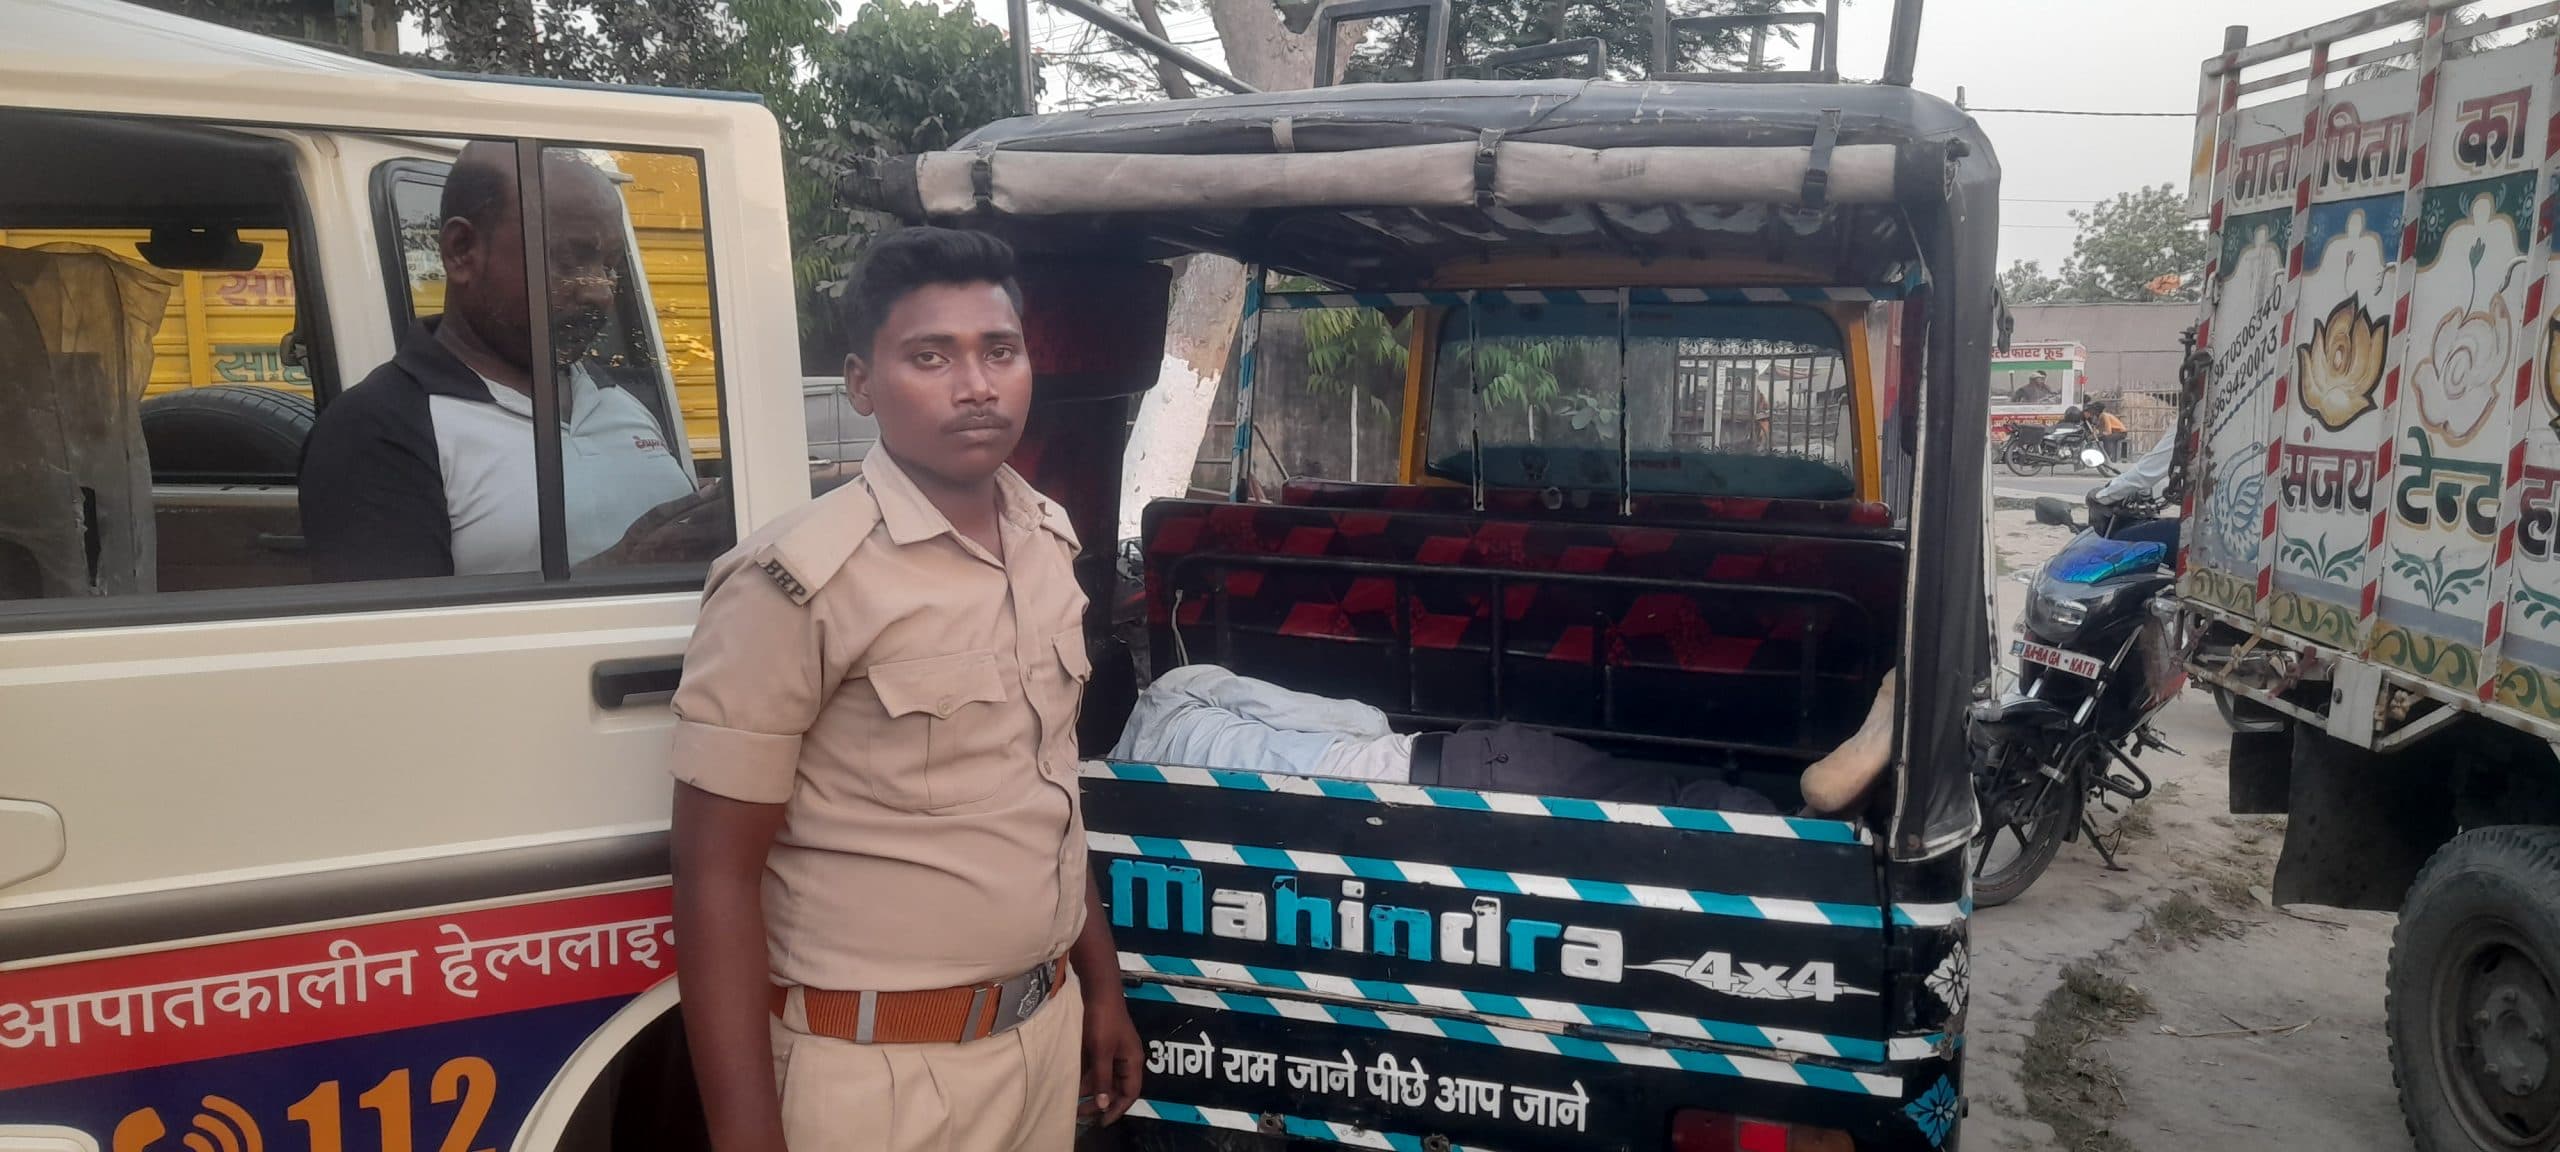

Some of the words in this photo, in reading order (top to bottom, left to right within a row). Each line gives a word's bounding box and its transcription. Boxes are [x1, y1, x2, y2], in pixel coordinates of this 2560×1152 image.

[2317, 101, 2415, 190] पिता
[2458, 86, 2532, 170] का
[2280, 426, 2377, 513] संजय
[2396, 426, 2502, 538] टेन्ट
[0, 939, 419, 1048] आपातकालीन
[287, 1056, 497, 1152] 112
[1146, 1031, 1215, 1079] आगे
[1222, 1047, 1278, 1087] राम
[1285, 1048, 1358, 1098] जाने
[1365, 1052, 1430, 1107] पीछे
[1434, 1076, 1504, 1119] आप
[1510, 1080, 1590, 1132] जाने
